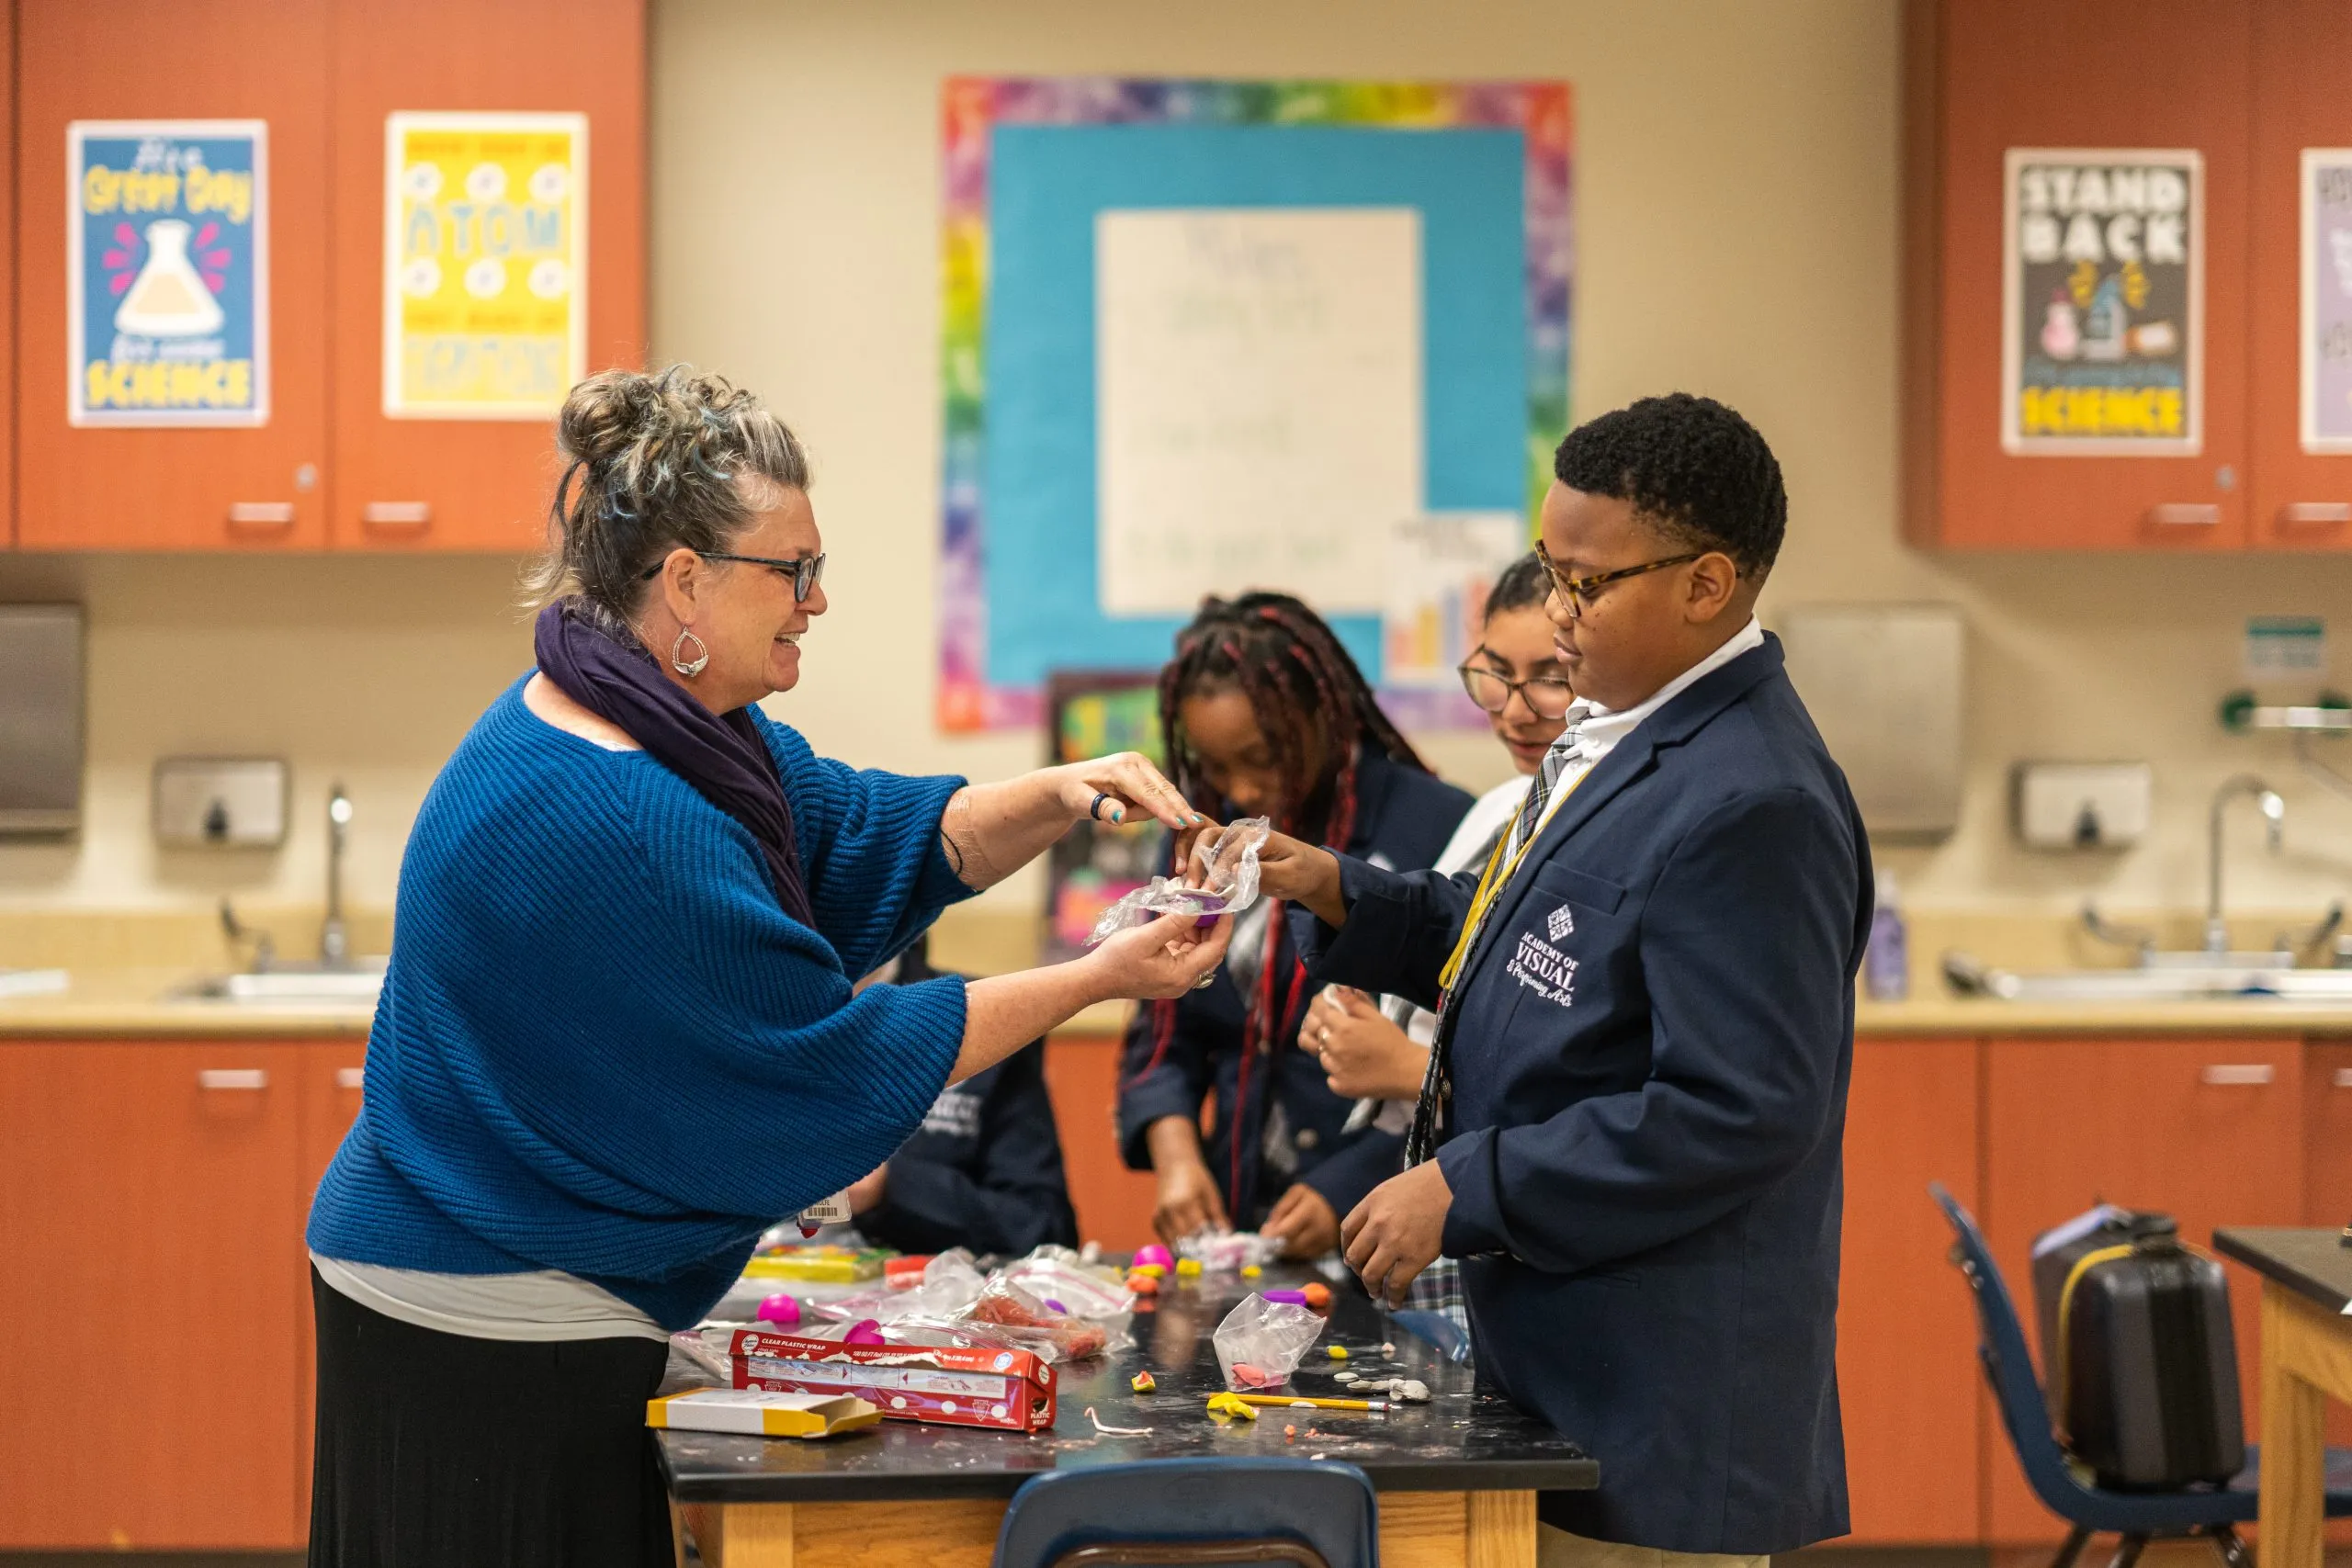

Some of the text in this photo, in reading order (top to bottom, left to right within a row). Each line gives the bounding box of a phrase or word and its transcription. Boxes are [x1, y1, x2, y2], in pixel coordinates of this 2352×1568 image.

[2021, 167, 2185, 211] STAND
[407, 202, 561, 258] ATOM
[2021, 213, 2184, 263] BACK
[86, 359, 250, 407] SCIENCE
[2021, 387, 2183, 433] SCIENCE
[1515, 942, 1576, 992] VISUAL
[1521, 931, 1579, 971] ACADEMY OF
[1547, 989, 1572, 1008] Arts
[780, 1340, 807, 1349] PLASTIC
[807, 1343, 826, 1351] WRAP
